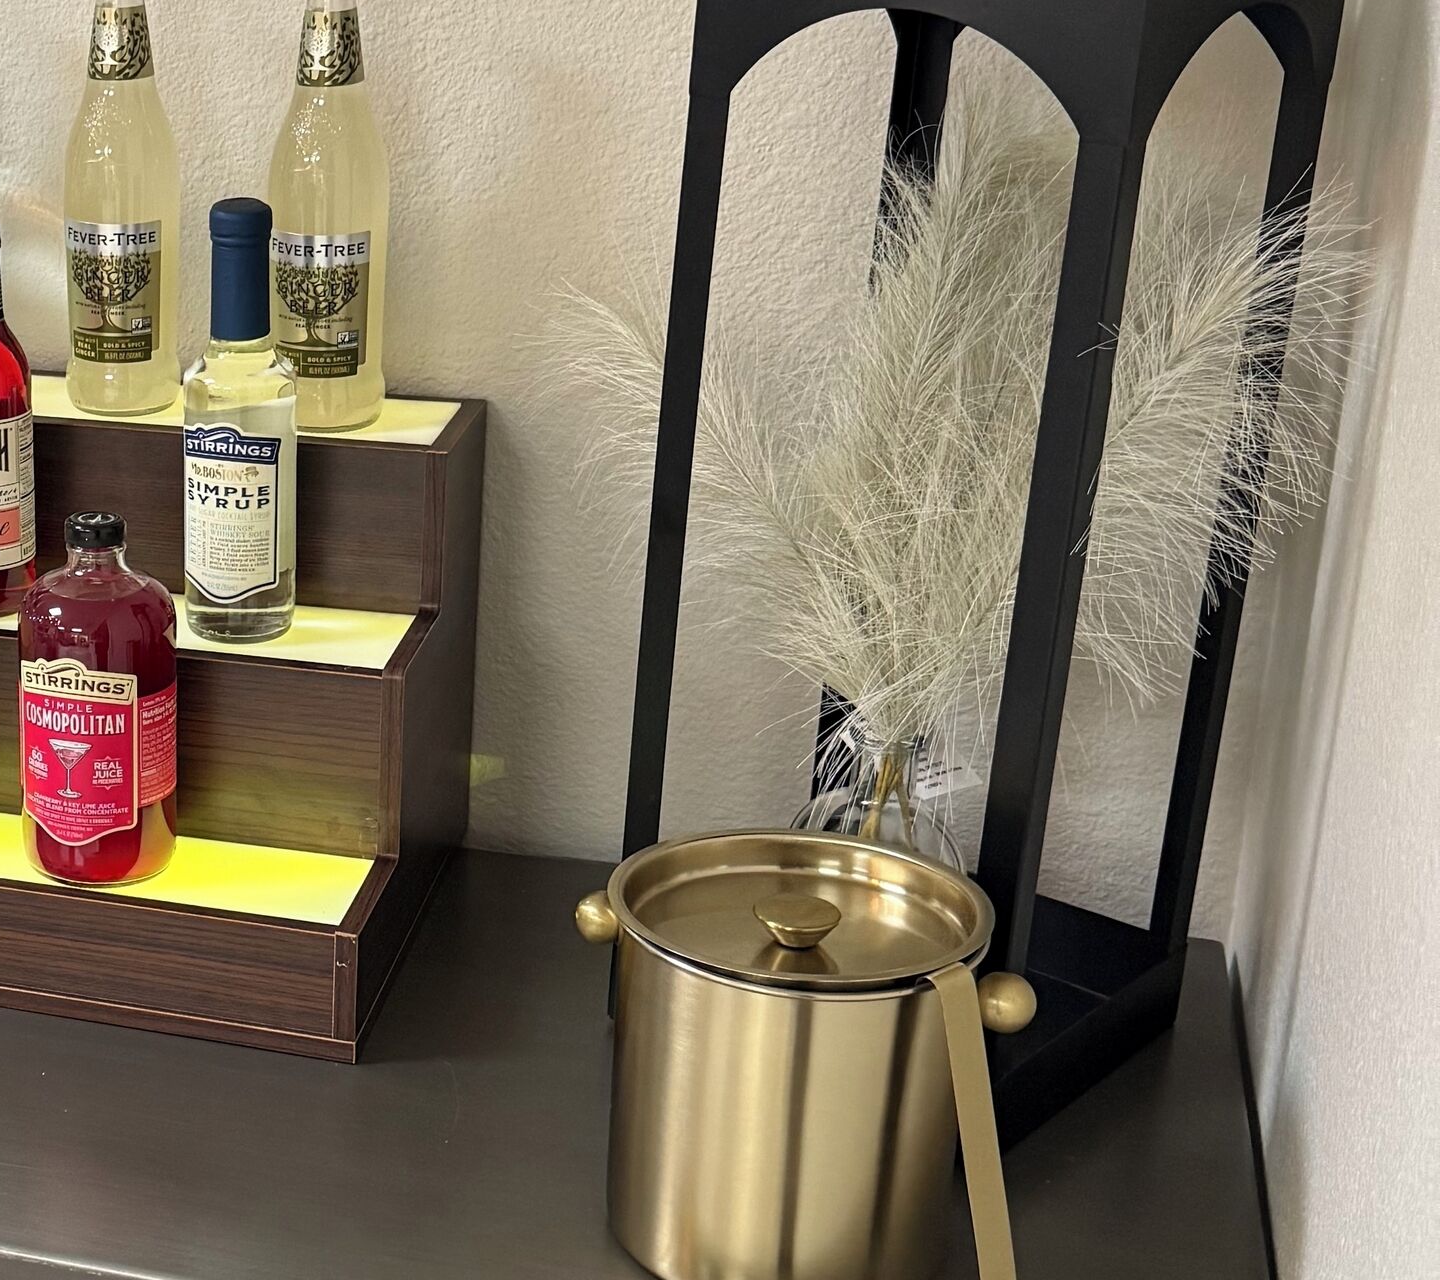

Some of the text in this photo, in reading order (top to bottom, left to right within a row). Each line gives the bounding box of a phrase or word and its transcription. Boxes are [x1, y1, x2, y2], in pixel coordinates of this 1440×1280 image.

[68, 226, 156, 246] FEVER-TREE
[272, 237, 366, 258] FEVER-TREE
[74, 267, 146, 284] GINGER
[85, 287, 132, 301] BEER
[277, 280, 357, 298] GINGER
[289, 299, 340, 315] BEER
[186, 437, 272, 458] STIRRINGS
[188, 478, 270, 498] SIMPLE
[188, 490, 270, 510] SYRUP
[25, 671, 125, 695] STIRRINGS
[44, 698, 93, 713] SIMPLE
[26, 701, 125, 735] COSMOPOLITAN
[31, 749, 43, 762] 60
[92, 769, 123, 779] JUICE
[93, 761, 122, 770] REAL
[83, 807, 129, 816] CONCENTRATE
